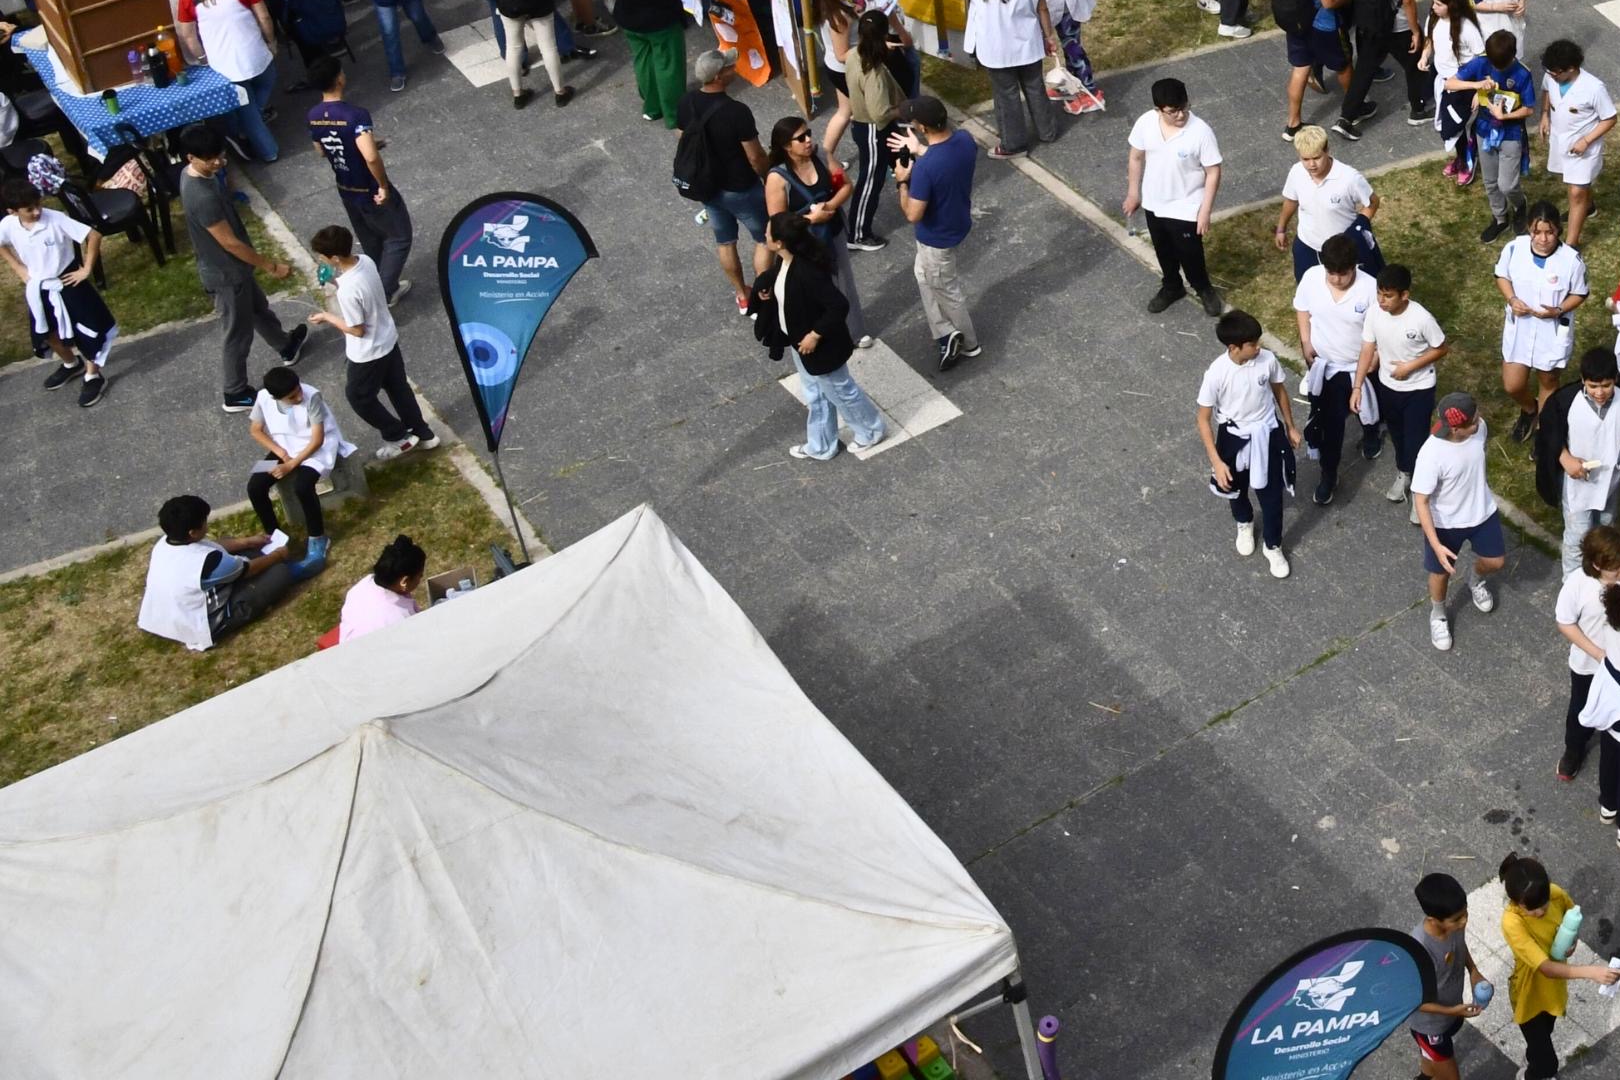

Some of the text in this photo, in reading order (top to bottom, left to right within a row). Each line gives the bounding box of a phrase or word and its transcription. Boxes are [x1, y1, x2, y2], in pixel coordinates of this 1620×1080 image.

[462, 254, 559, 269] LA PAMPA
[479, 291, 514, 299] Ministerio
[1251, 1010, 1380, 1045] LA PAMPA
[1273, 1034, 1351, 1055] Desarrollo Social
[1288, 1048, 1330, 1061] MINISTERIO
[1261, 1069, 1306, 1080] Ministerio
[1306, 1066, 1320, 1074] en
